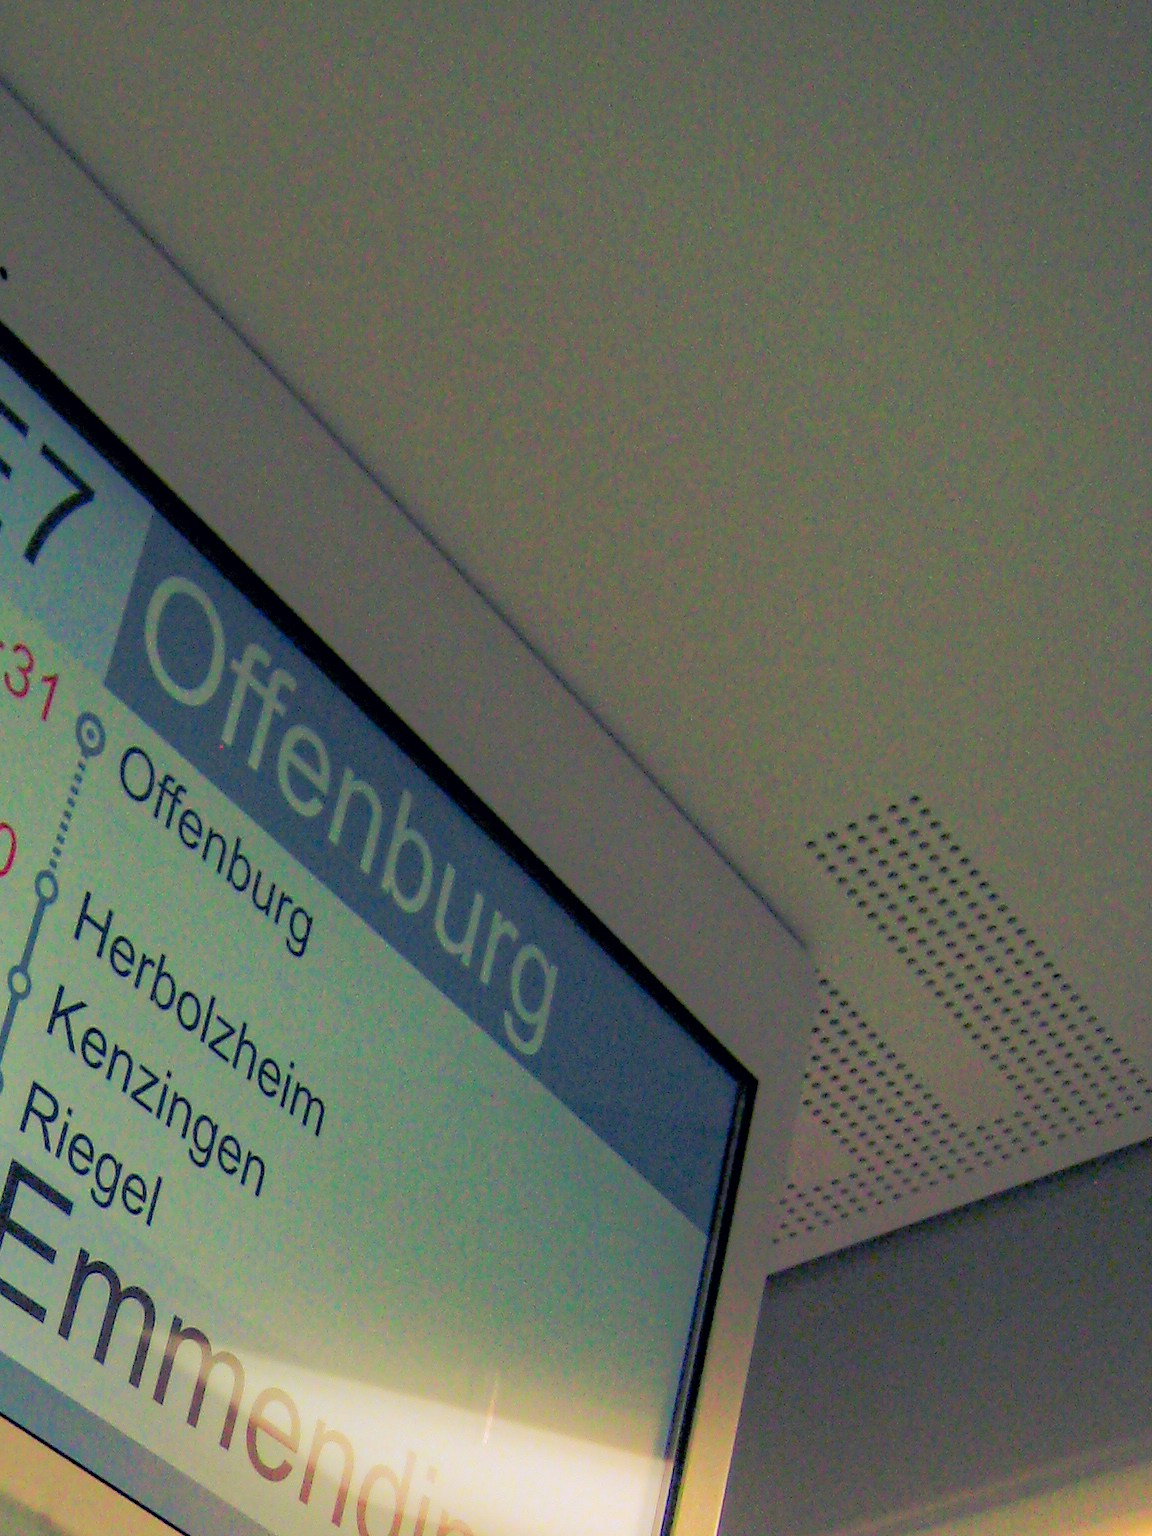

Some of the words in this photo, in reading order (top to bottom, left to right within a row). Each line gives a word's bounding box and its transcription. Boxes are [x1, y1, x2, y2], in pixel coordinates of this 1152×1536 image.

[119, 746, 314, 957] Offenburg
[144, 576, 558, 1056] Offenburg
[47, 984, 265, 1197] Kenzingen
[74, 891, 325, 1137] Herbolzheim
[19, 1080, 162, 1227] Riegel
